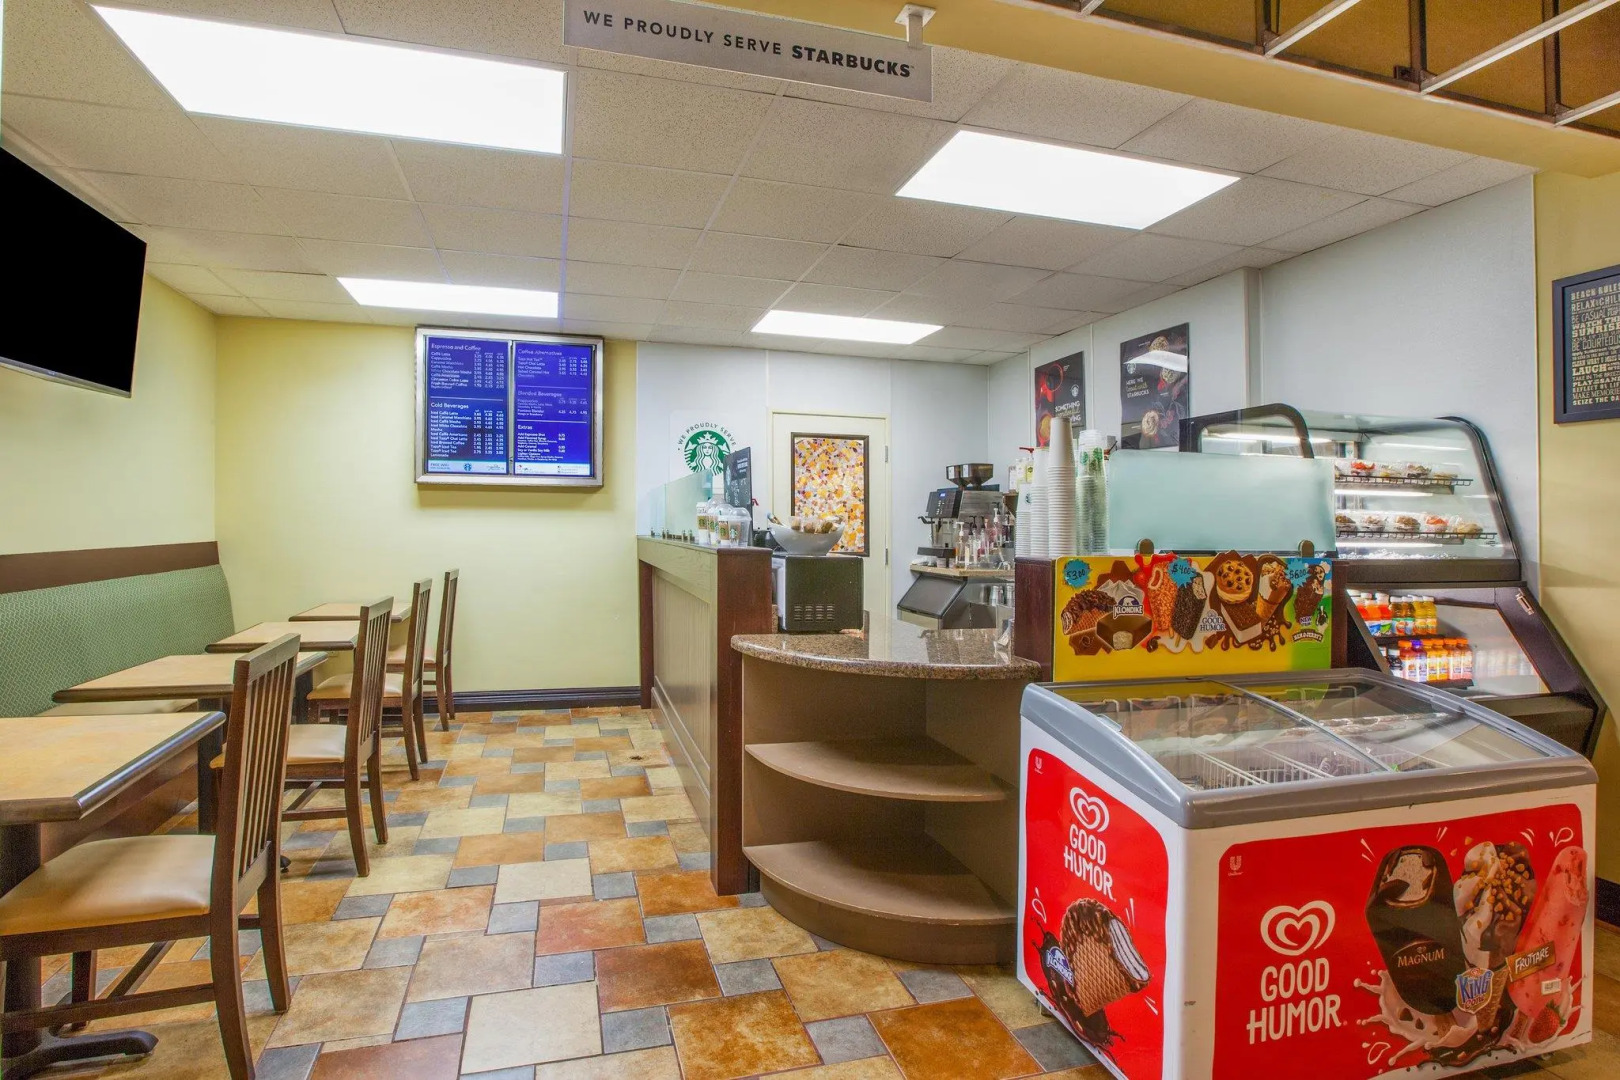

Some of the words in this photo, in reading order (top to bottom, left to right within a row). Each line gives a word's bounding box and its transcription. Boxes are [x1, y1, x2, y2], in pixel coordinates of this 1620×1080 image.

[584, 10, 613, 28] WE
[624, 17, 714, 44] PROUDLY
[724, 34, 781, 56] SERVE
[1571, 299, 1596, 311] RELAX
[1572, 319, 1602, 330] WATCH
[1572, 363, 1607, 376] LAUGH
[1127, 390, 1149, 398] STARBUCKS
[1573, 392, 1589, 400] MAKE
[1055, 401, 1080, 412] SOMETHING
[678, 434, 686, 445] WE
[686, 422, 718, 434] PROUDLY
[720, 427, 737, 446] SERVE
[1114, 606, 1143, 618] KLONDIKE
[1070, 824, 1106, 866] GOOD
[1064, 846, 1114, 900] HUMOR
[1047, 951, 1074, 986] KLONDIKE
[1397, 948, 1445, 968] MAGNUM
[1515, 947, 1550, 974] FRUTTARE
[1261, 958, 1330, 1002] GOOD
[1246, 994, 1342, 1045] HUMOR
